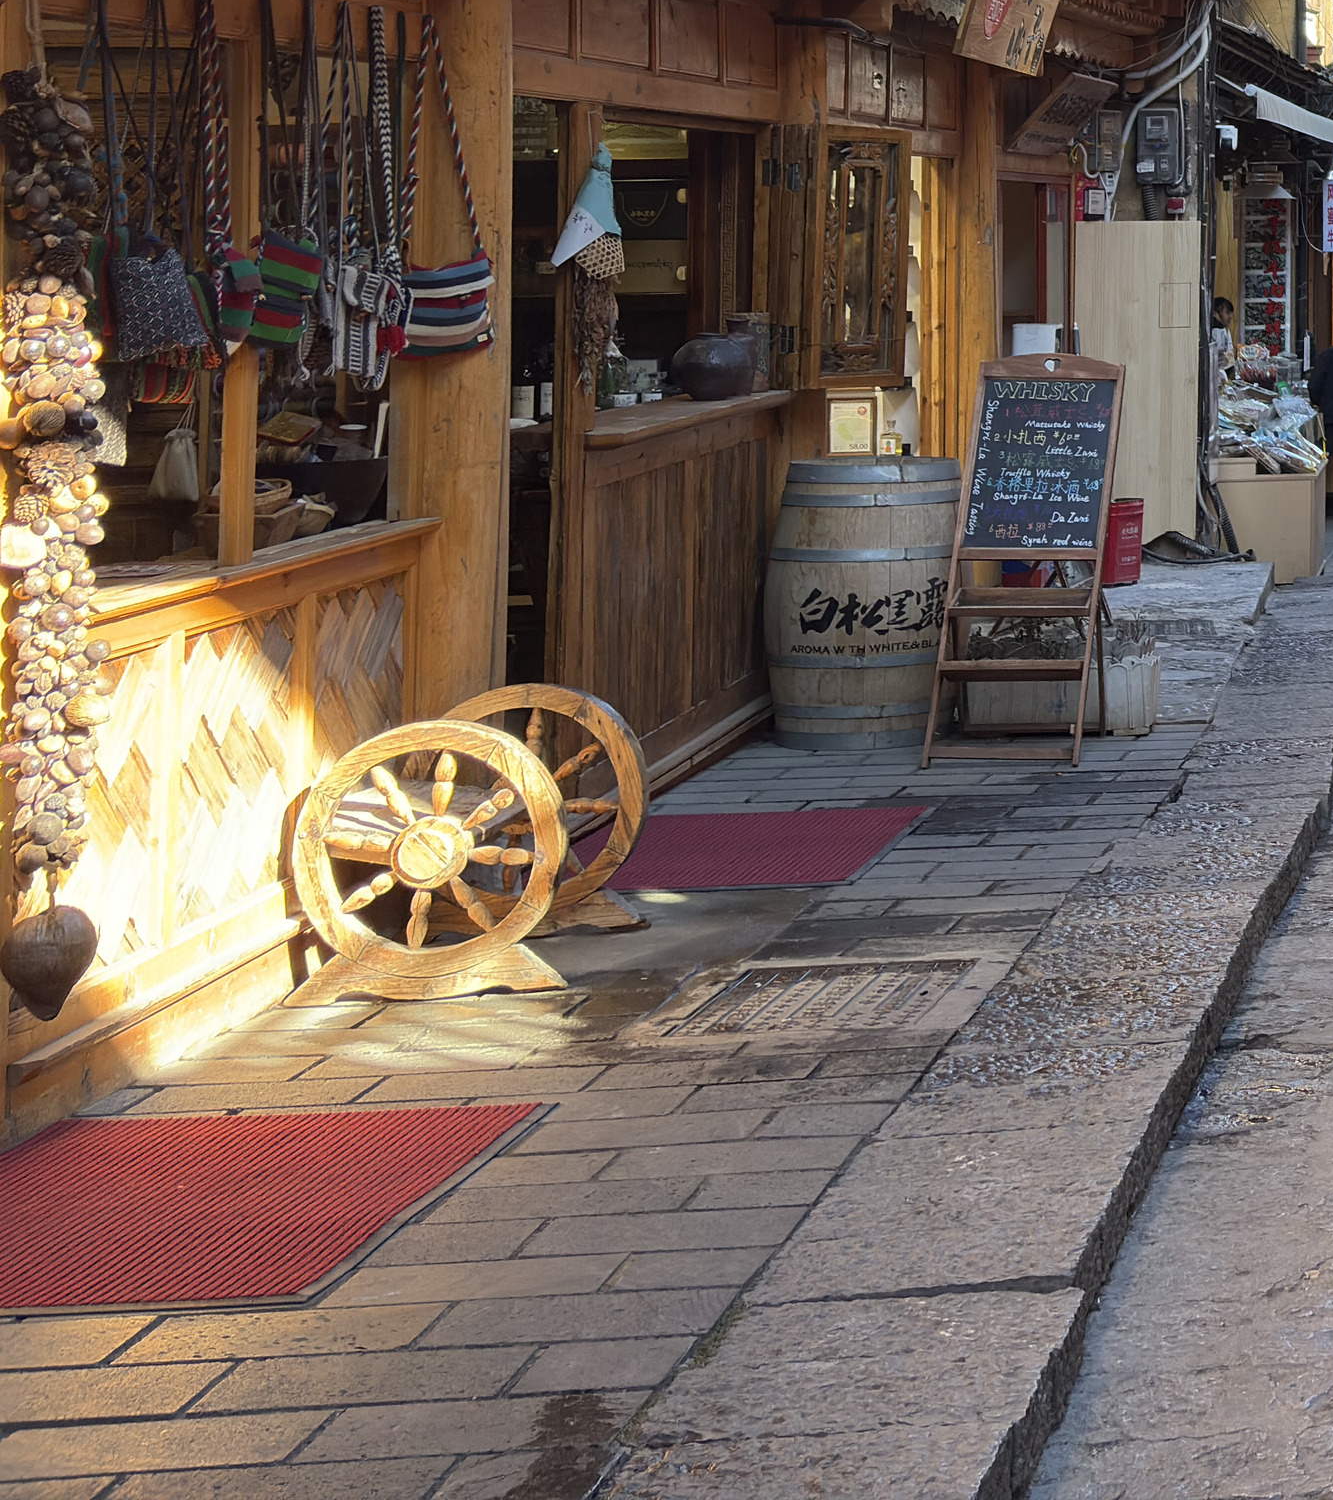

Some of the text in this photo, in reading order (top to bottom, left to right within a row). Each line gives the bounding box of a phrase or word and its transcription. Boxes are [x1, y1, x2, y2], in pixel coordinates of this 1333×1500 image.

[993, 381, 1096, 402] WHISKY
[1003, 429, 1047, 447] 小扎西
[1000, 467, 1032, 480] Truffle
[994, 477, 1080, 495] 香格里拉冰酒
[791, 644, 831, 655] AROMA
[834, 645, 866, 655] WTH
